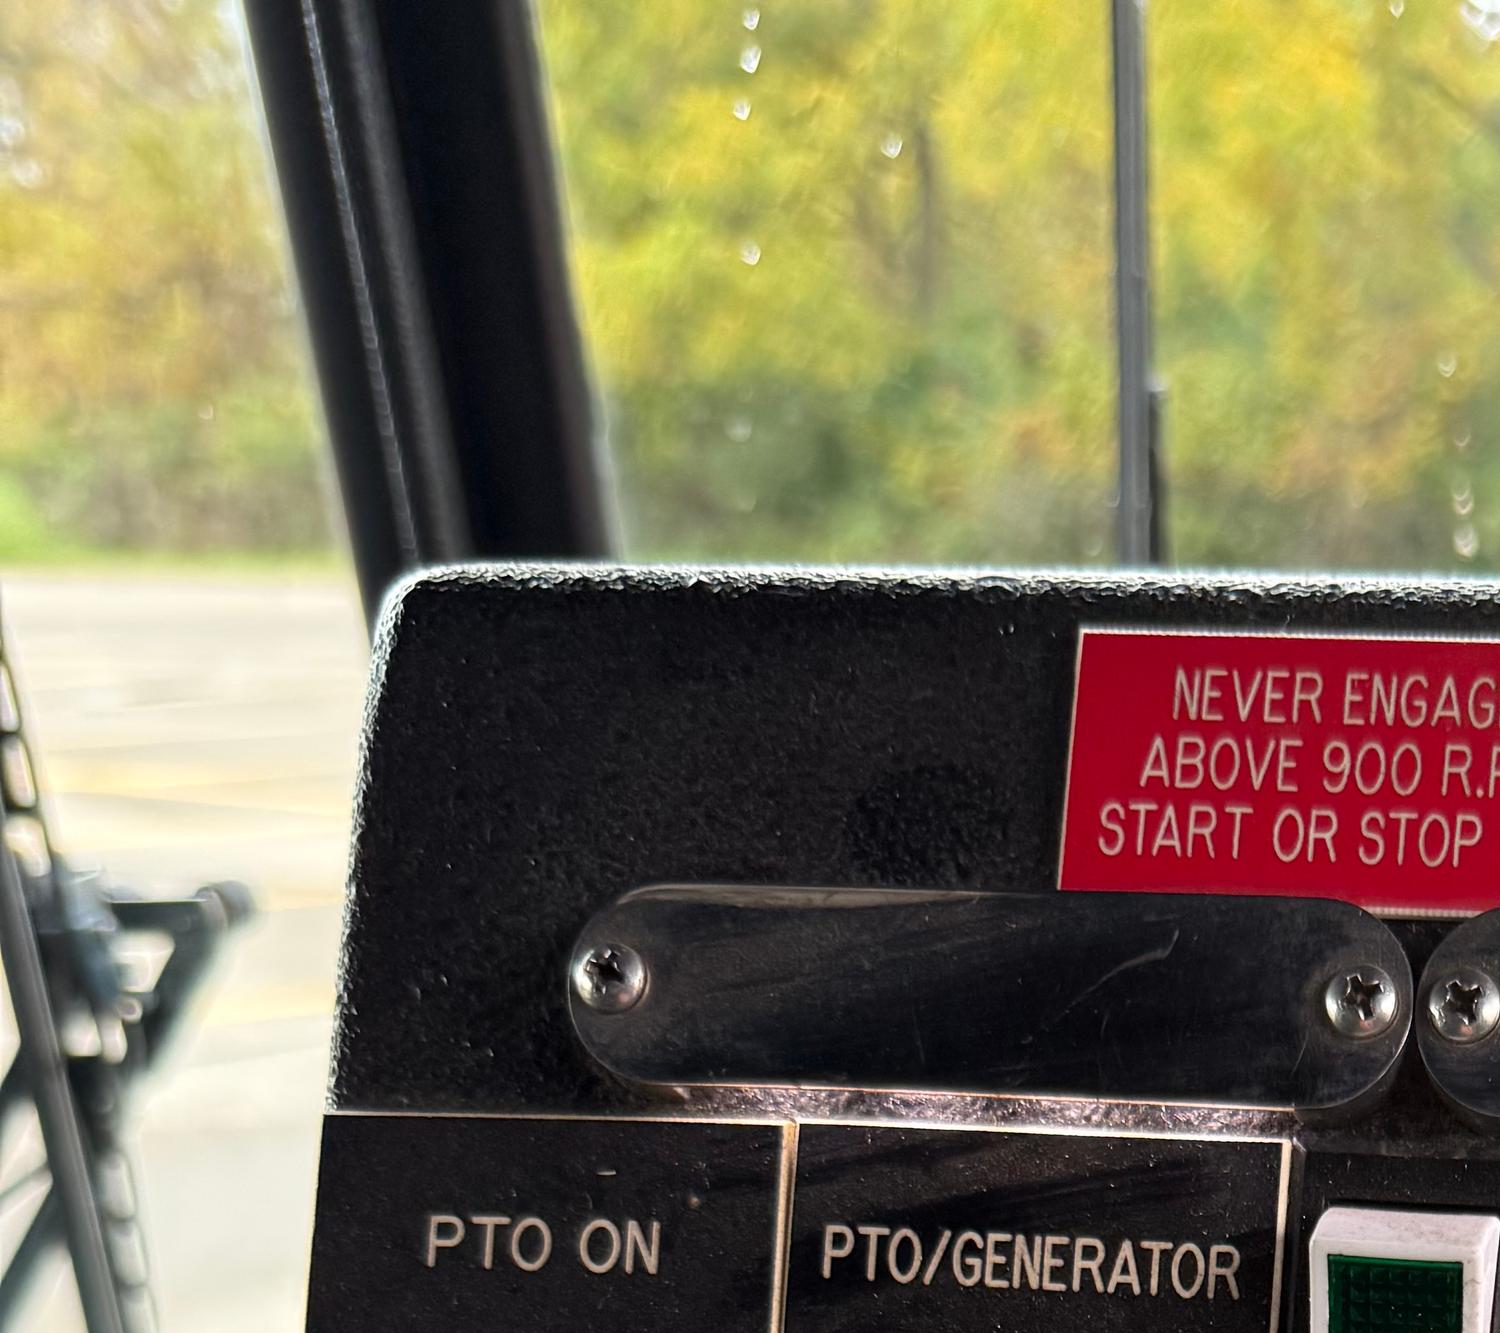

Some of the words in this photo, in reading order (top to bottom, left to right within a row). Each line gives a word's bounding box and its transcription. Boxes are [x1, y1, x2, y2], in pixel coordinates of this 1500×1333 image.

[1173, 667, 1324, 726] NEVER
[1140, 736, 1301, 794] ABOVE
[1321, 741, 1423, 796] 900
[1097, 804, 1252, 863] START
[1272, 809, 1337, 864] OR
[1358, 813, 1483, 870] STOP
[425, 1214, 553, 1272] PTO
[578, 1219, 660, 1275] ON
[820, 1224, 1240, 1301] PTO/GENERATOR
